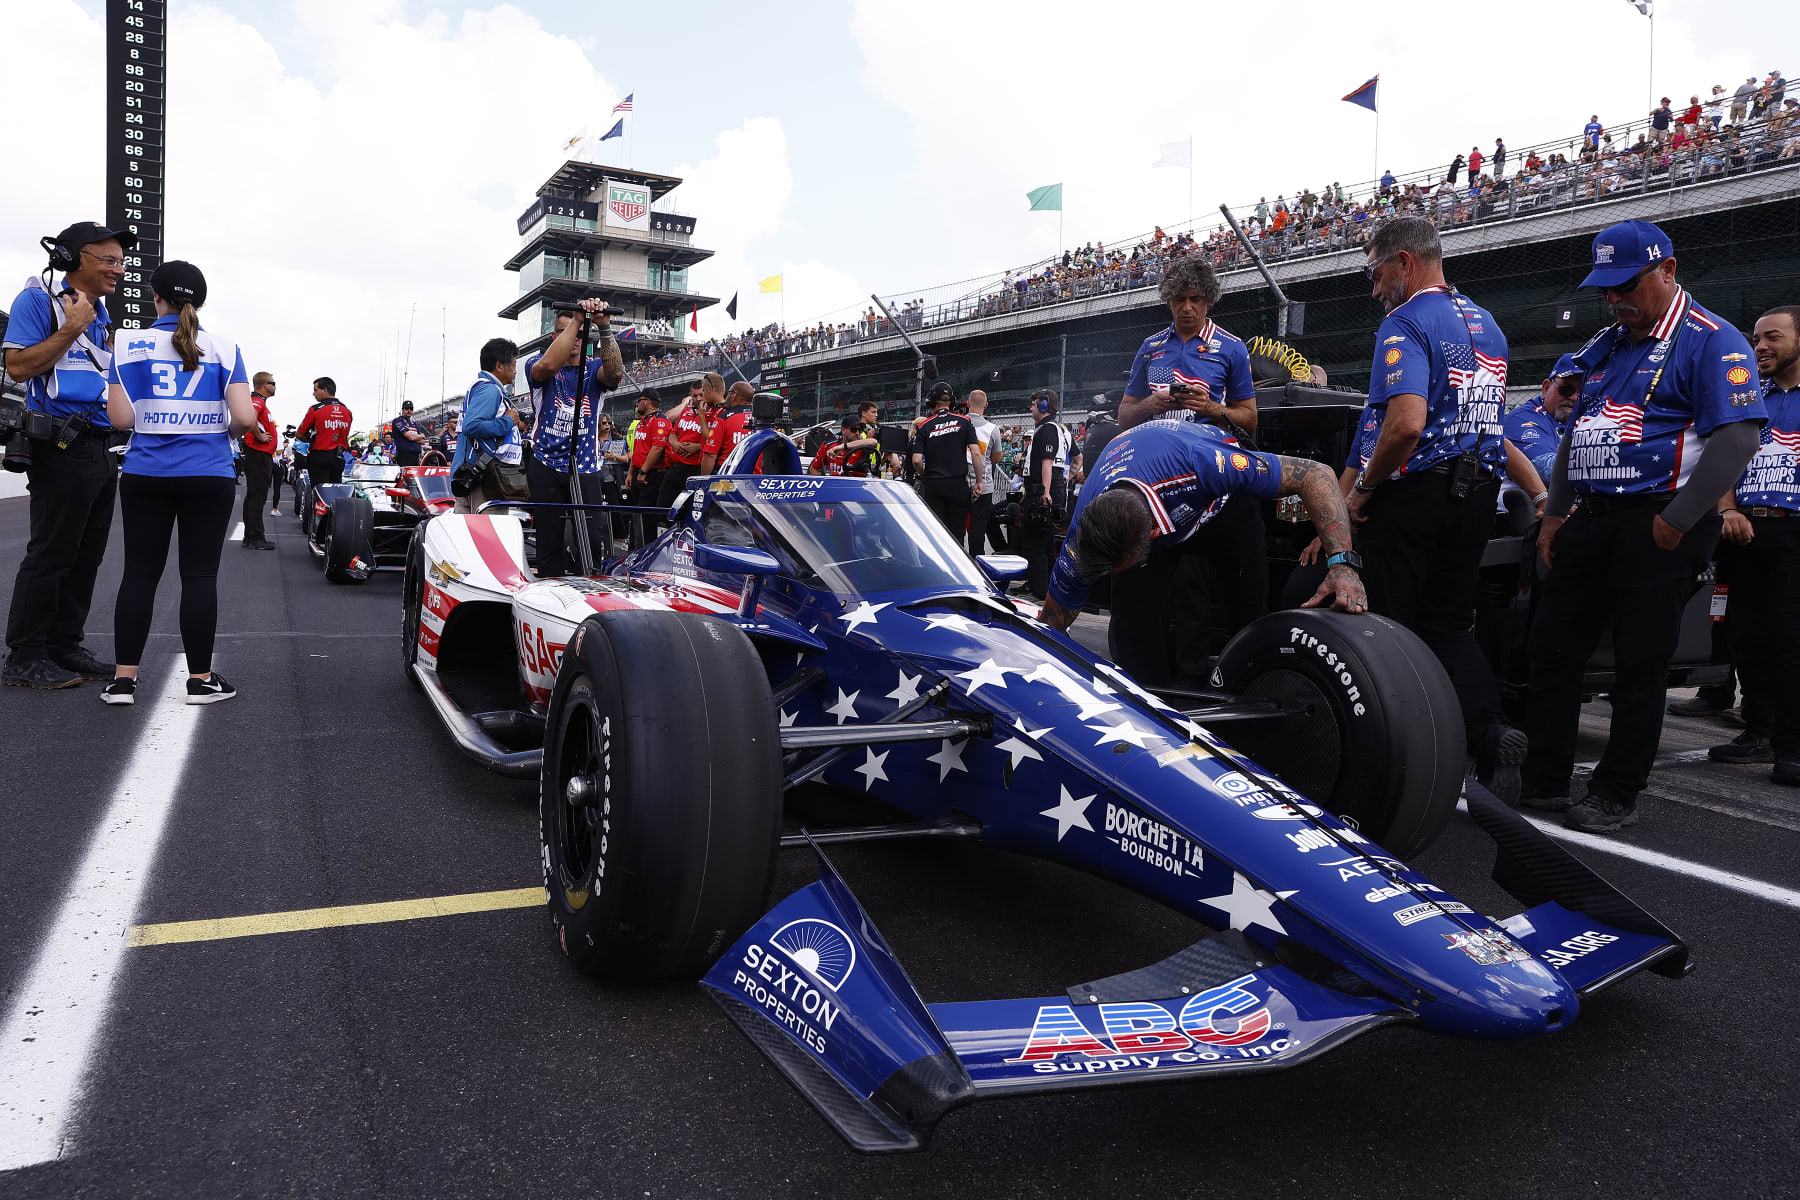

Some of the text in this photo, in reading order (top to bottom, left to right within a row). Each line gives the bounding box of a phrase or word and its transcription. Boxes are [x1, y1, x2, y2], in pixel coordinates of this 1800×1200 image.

[126, 0, 144, 11] 14
[125, 16, 144, 28] 45
[125, 32, 144, 44] 28
[130, 48, 140, 59] 8
[125, 64, 144, 76] 98
[125, 80, 144, 92] 20
[126, 96, 142, 108] 51
[125, 112, 144, 125] 24
[125, 128, 144, 141] 30
[125, 144, 144, 156] 66
[129, 161, 139, 171] 5
[124, 176, 143, 188] 60
[126, 192, 143, 204] 10
[613, 190, 645, 204] TAG
[124, 208, 142, 220] 75
[548, 205, 585, 218] 1 2 3 4
[612, 201, 645, 218] HEUER
[128, 225, 138, 235] 9
[656, 221, 691, 234] 5 6 7 8
[1646, 243, 1662, 261] 14
[124, 256, 142, 270] 26
[123, 271, 142, 283] 23
[123, 287, 142, 298] 33
[124, 303, 141, 314] 15
[1562, 310, 1571, 321] 6
[122, 318, 142, 330] 06
[151, 362, 205, 398] 37
[993, 370, 999, 378] 7
[143, 411, 225, 425] PHOTO/VIDEO
[934, 420, 959, 430] TEAM
[929, 426, 962, 439] PENSKE
[758, 478, 825, 490] SEXTON
[754, 490, 817, 500] PROPERTIES
[673, 552, 694, 566] SEXTO
[672, 565, 698, 579] PROPERTIES
[1289, 626, 1367, 718] Firestone
[1234, 790, 1305, 807] INDYAR
[593, 716, 612, 898] Firestone
[1105, 802, 1205, 872] BORCHETTA
[1121, 836, 1183, 877] BOURBON
[743, 943, 840, 1032] SEXTON
[733, 968, 827, 1055] PROPERTIES
[1002, 973, 1272, 1063] ABC
[1031, 1036, 1302, 1075] Supply Co. Inc.
